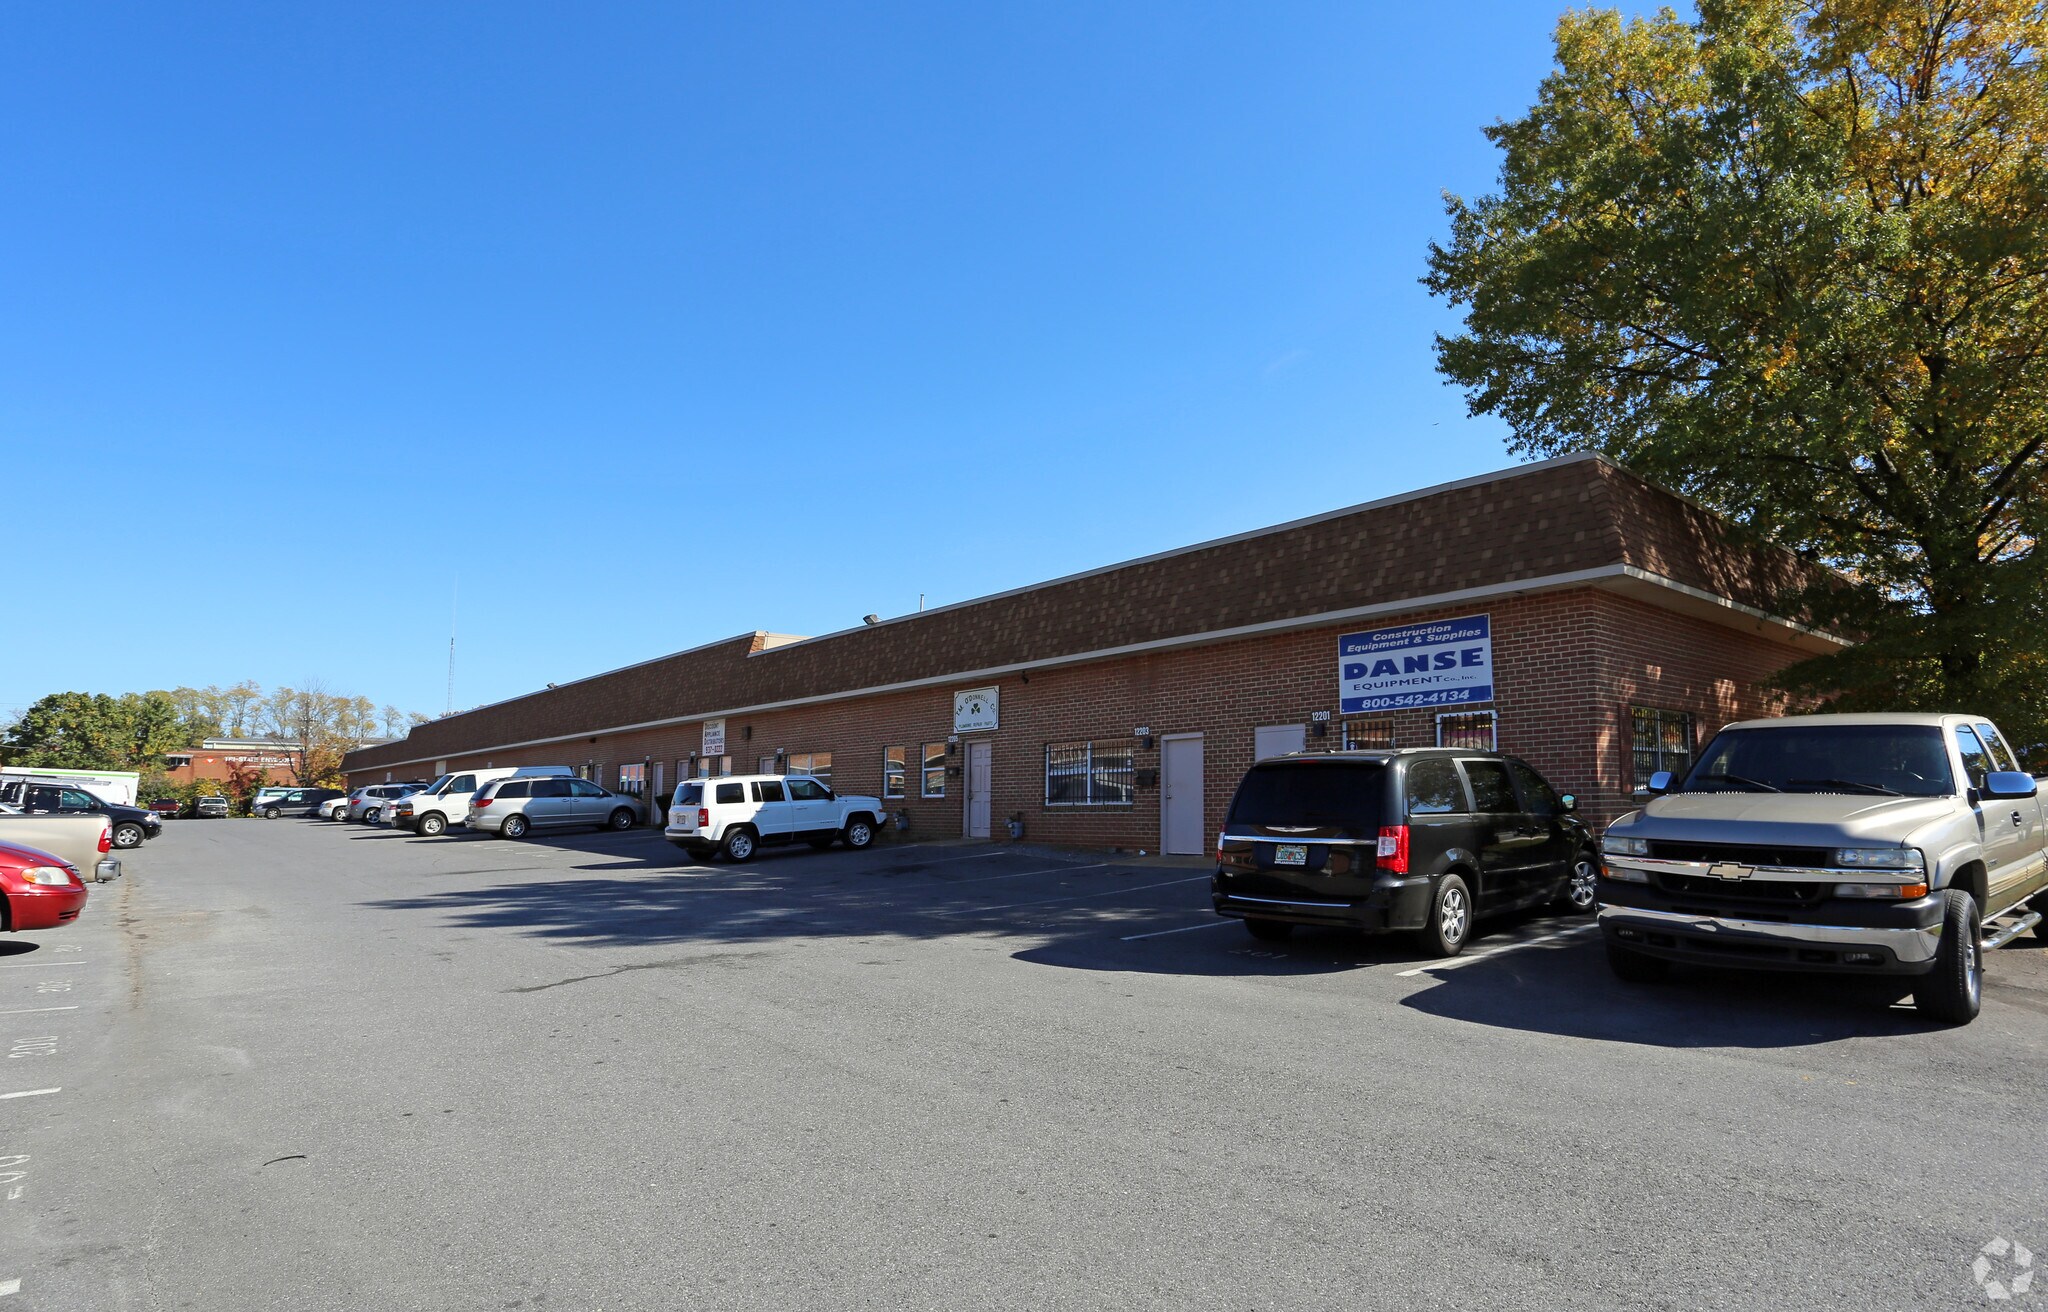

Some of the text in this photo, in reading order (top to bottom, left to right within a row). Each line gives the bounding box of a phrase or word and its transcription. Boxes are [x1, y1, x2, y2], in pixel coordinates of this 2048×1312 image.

[1347, 629, 1481, 653] Equipment & Supplies
[1373, 625, 1451, 642] Construction
[1344, 647, 1484, 681] DANSE
[1353, 675, 1442, 691] EQUIPMENT
[1361, 689, 1470, 709] 800-542-4134
[1311, 711, 1330, 721] 12201
